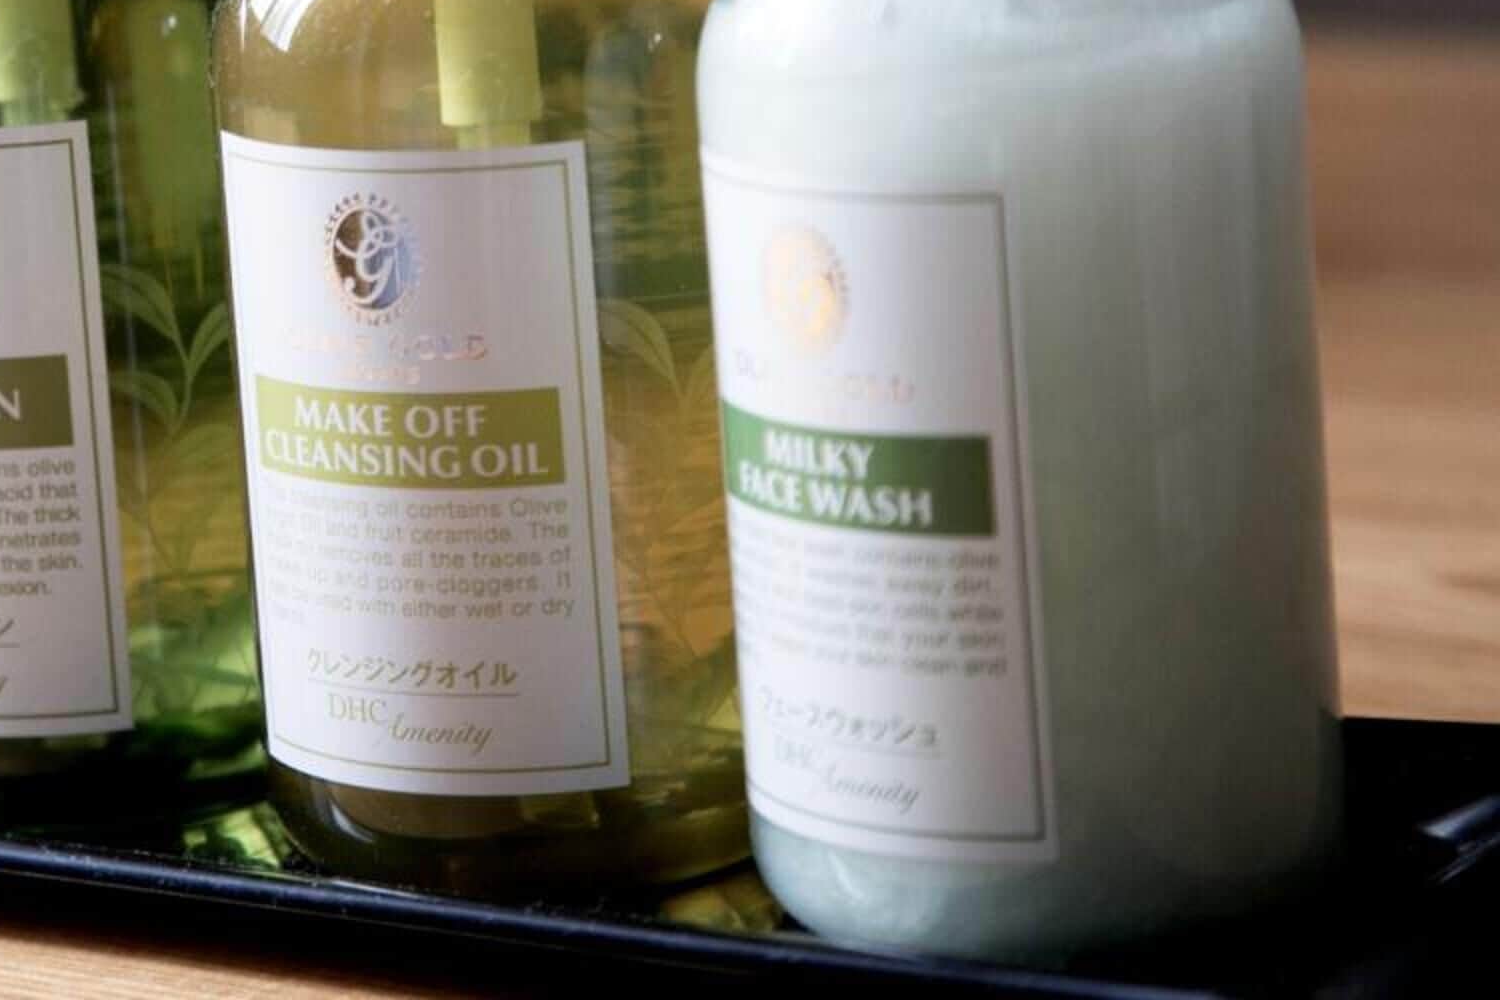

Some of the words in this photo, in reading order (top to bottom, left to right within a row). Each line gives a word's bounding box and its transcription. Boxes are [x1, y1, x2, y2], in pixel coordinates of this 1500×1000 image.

[292, 395, 393, 437] MAKE
[404, 404, 489, 439] OFF
[266, 428, 462, 479] CLEANSING
[470, 442, 549, 476] OIL
[764, 427, 875, 480] MILKY
[375, 500, 398, 516] oil
[405, 501, 502, 520] contains
[509, 496, 568, 516] Olive
[738, 459, 804, 512] FACE
[806, 480, 933, 527] WASH
[529, 521, 570, 541] The
[0, 554, 33, 573] the
[401, 550, 424, 569] all
[430, 550, 466, 569] the
[472, 551, 543, 568] traces
[550, 545, 572, 566] of
[402, 600, 457, 620] either
[464, 601, 503, 620] wet
[511, 602, 534, 619] or
[541, 597, 576, 621] dry
[307, 647, 520, 689] クレンジングオイル
[326, 692, 388, 725] DHC
[381, 712, 493, 759] Amenity
